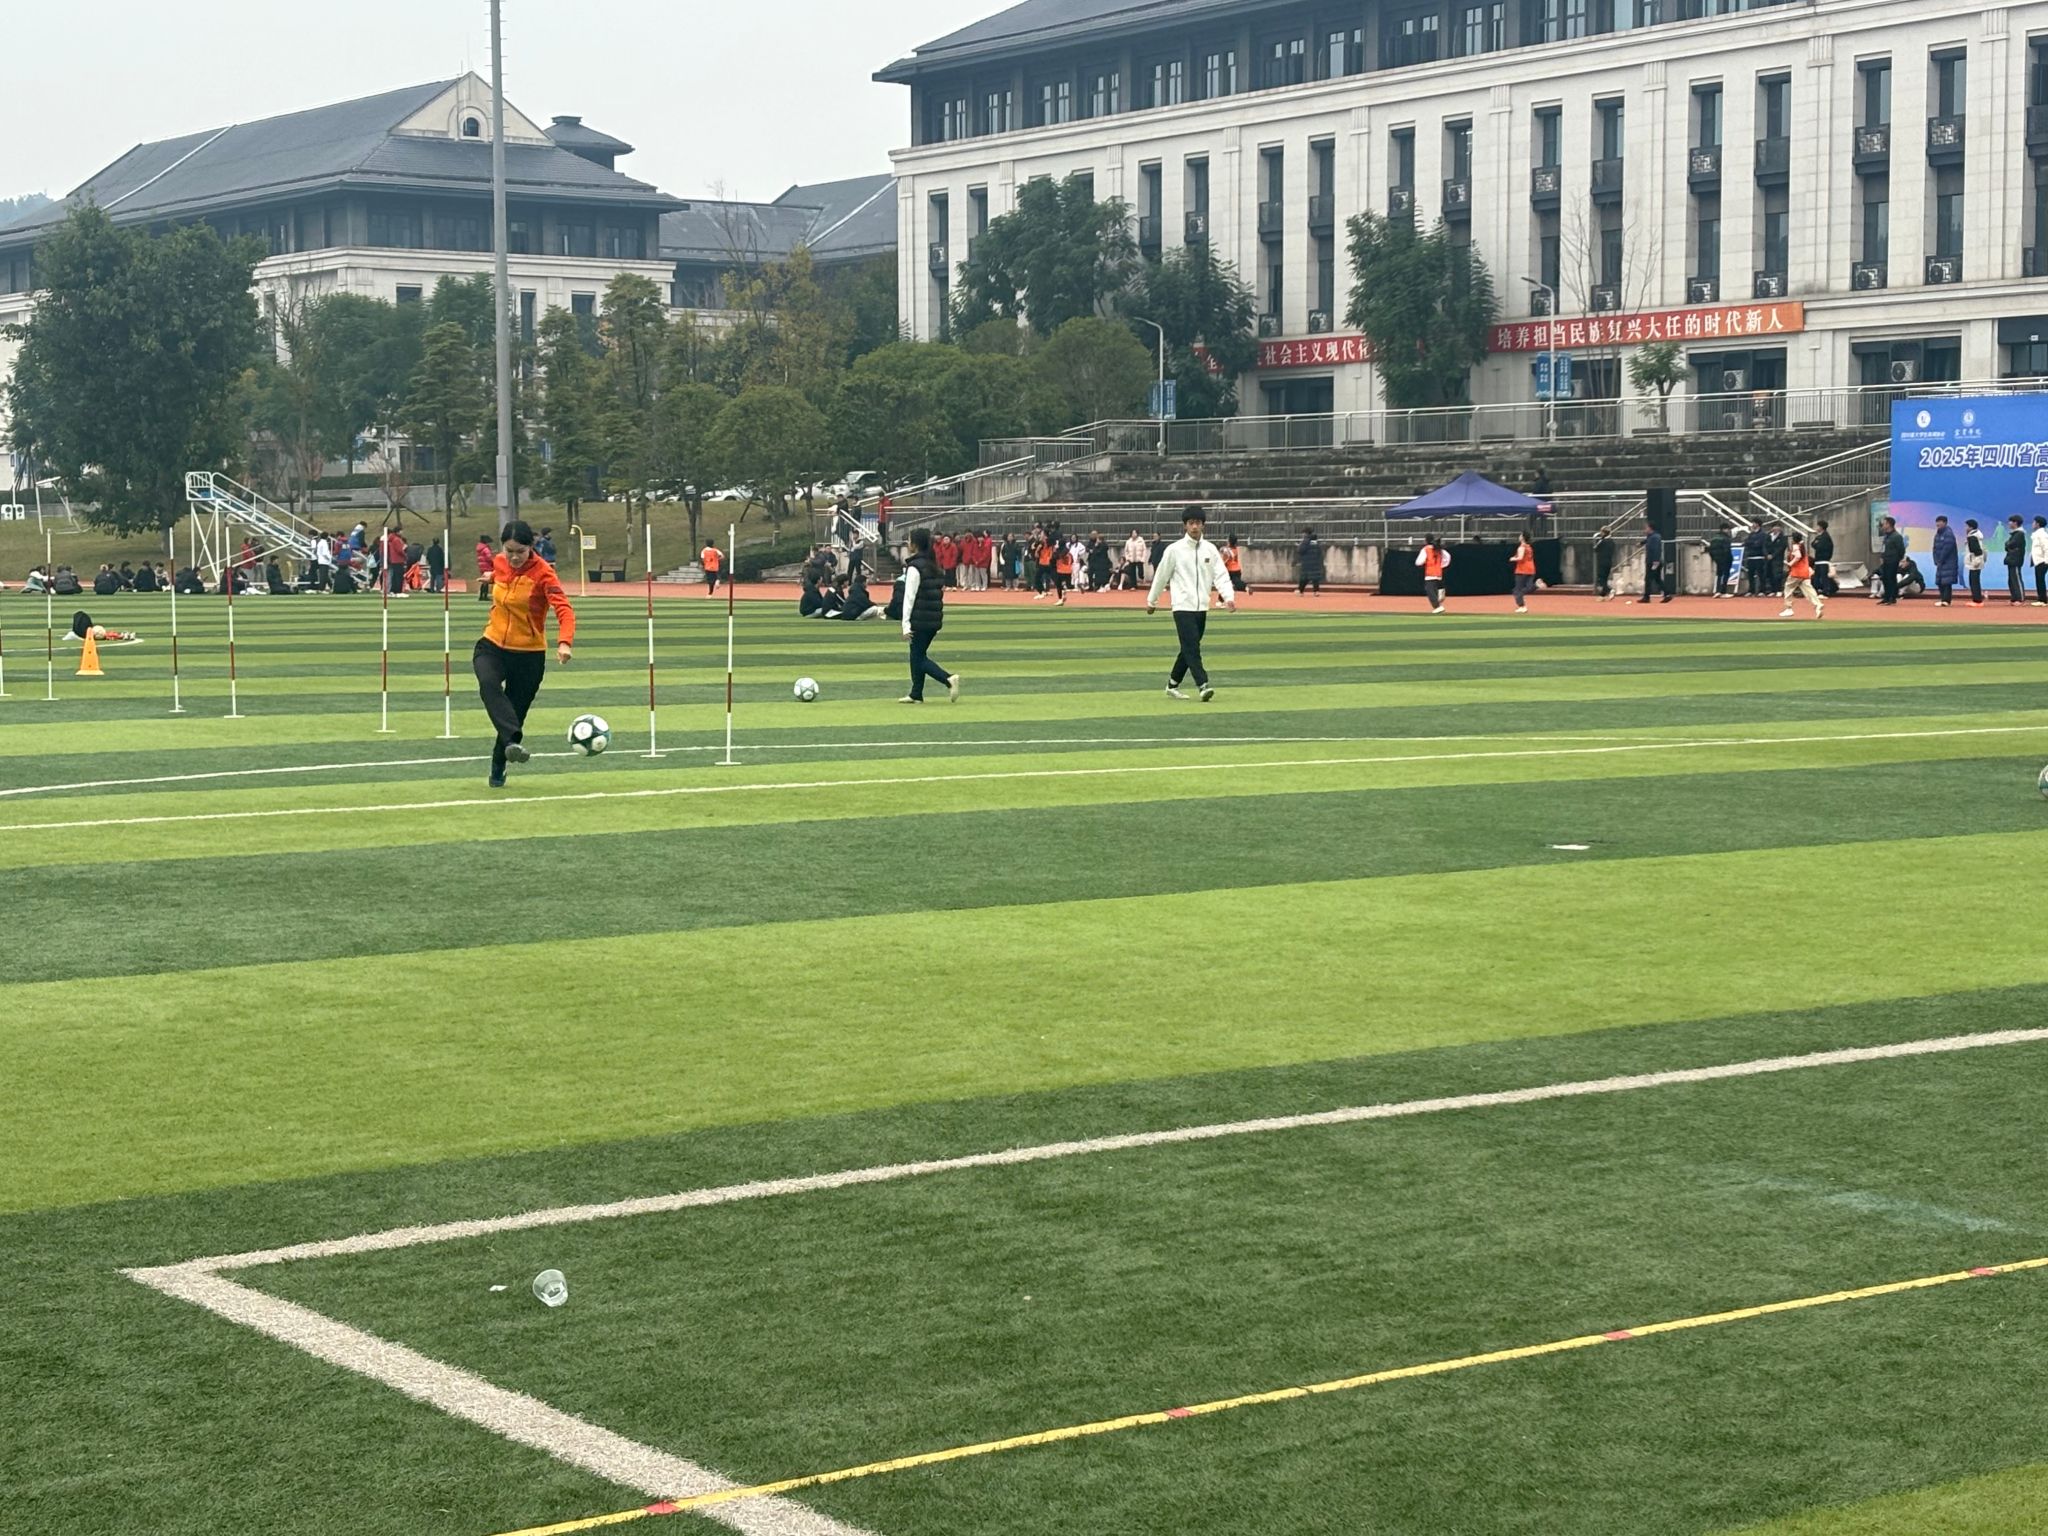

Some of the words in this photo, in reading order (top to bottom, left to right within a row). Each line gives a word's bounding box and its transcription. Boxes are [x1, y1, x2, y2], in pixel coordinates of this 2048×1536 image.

[1497, 308, 1785, 349] 培养担当民族复兴大任的时代新人
